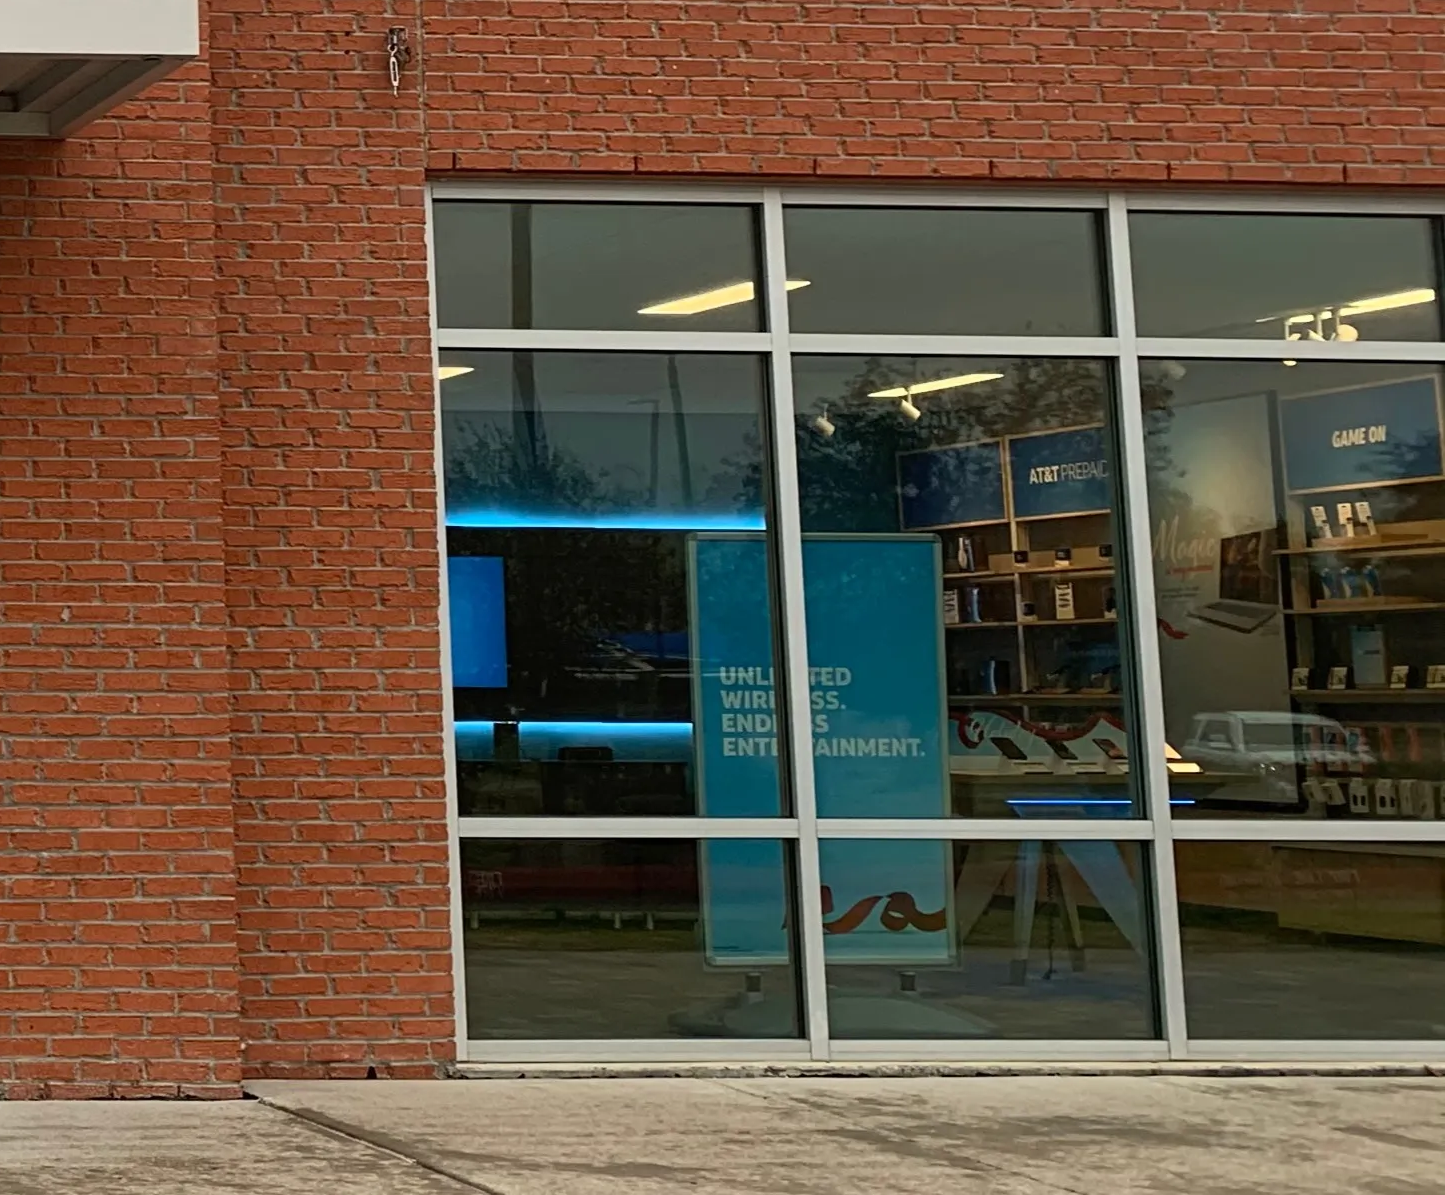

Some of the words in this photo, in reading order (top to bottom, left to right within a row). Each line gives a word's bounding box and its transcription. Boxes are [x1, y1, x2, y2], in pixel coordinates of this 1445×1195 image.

[1332, 427, 1366, 448] GAME
[1368, 425, 1387, 443] ON
[1029, 465, 1059, 485] AT&T
[719, 666, 852, 686] UNLITED
